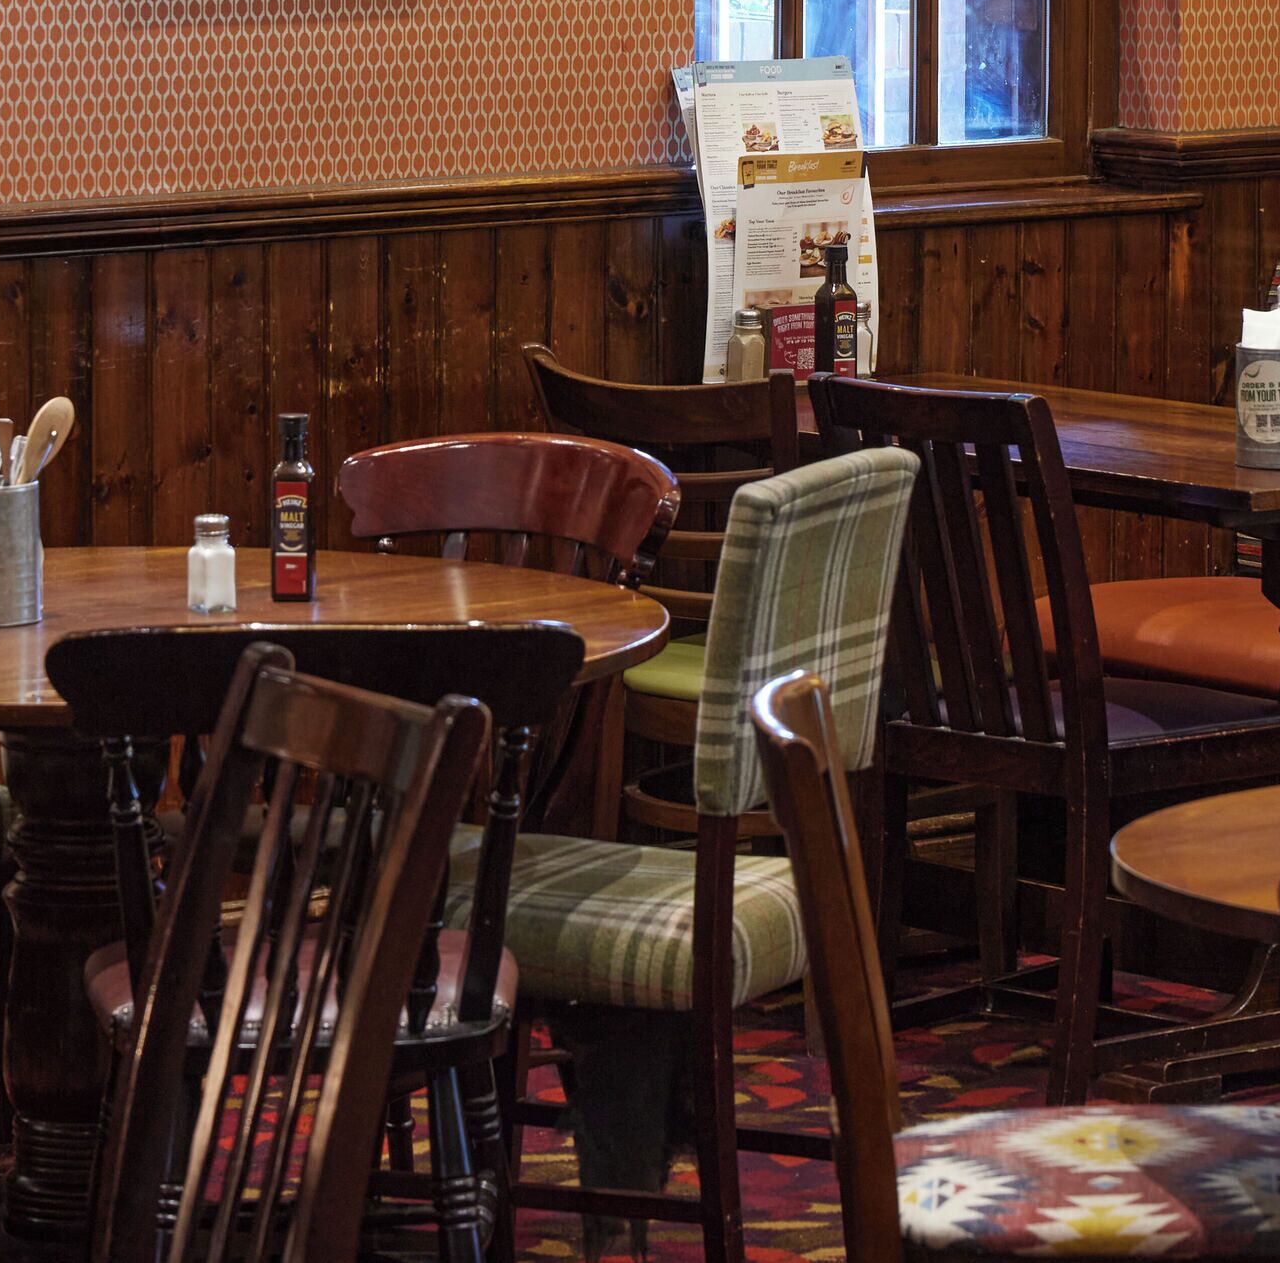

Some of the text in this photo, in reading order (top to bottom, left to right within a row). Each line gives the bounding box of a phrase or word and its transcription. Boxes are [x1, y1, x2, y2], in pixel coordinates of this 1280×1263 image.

[760, 65, 782, 75] FOOD
[788, 160, 820, 173] Breakfast
[837, 325, 854, 334] MALT
[1257, 389, 1276, 402] YOUR
[281, 512, 304, 521] MALT
